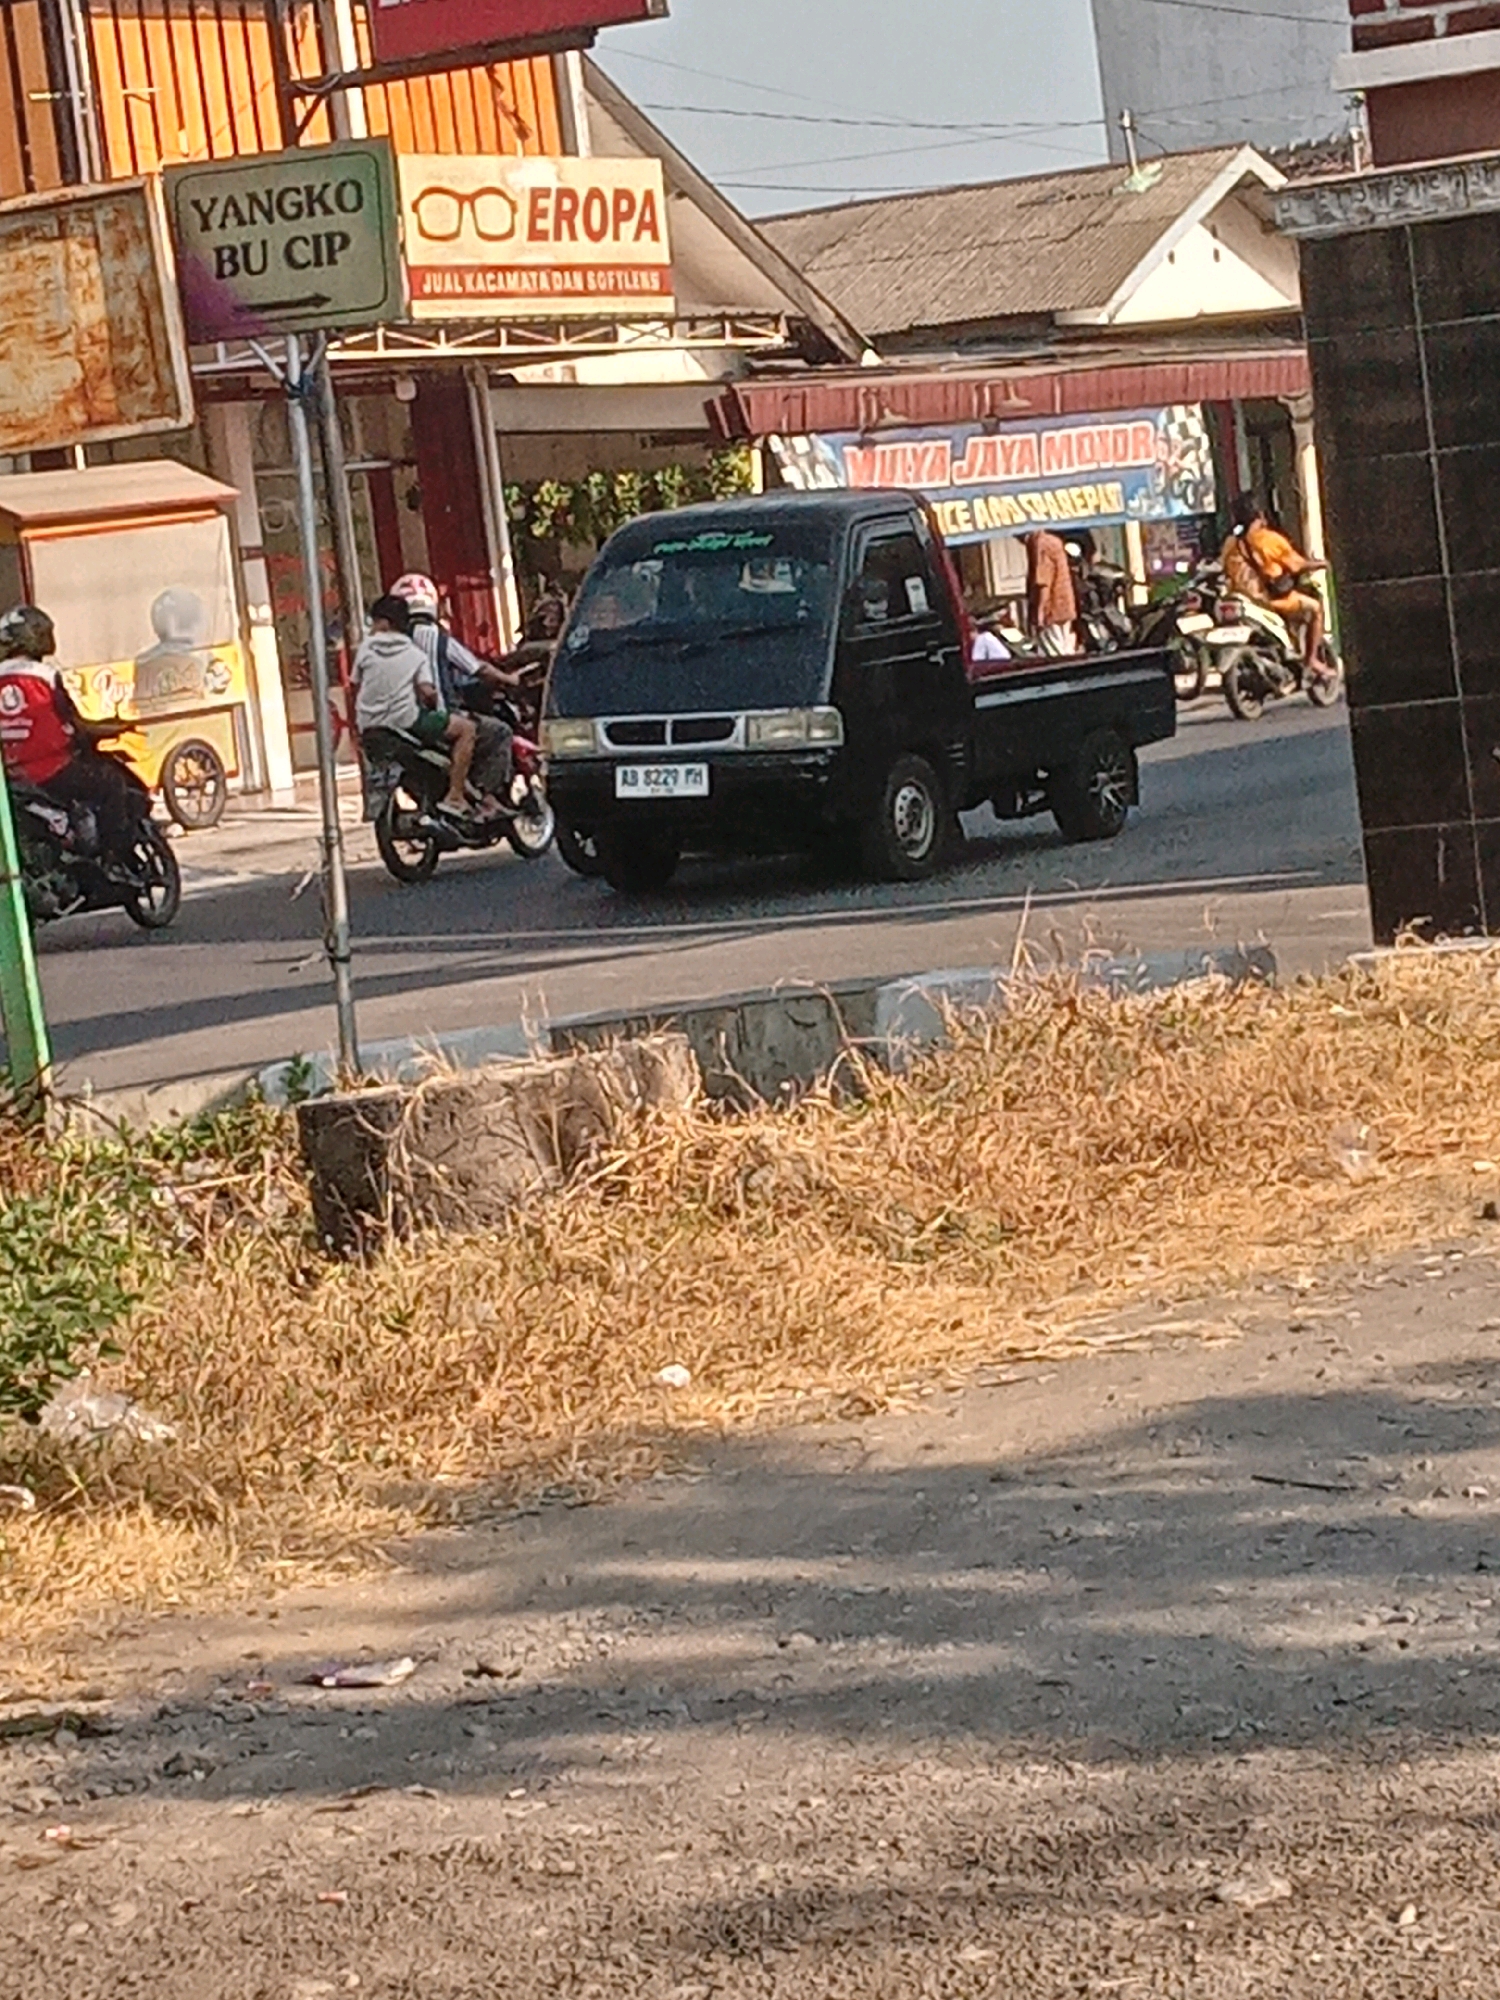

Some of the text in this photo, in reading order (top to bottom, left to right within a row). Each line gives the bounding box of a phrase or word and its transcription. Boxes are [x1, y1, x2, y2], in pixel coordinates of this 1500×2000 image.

[190, 179, 364, 233] YANGKO
[527, 187, 660, 243] EROPA
[213, 231, 351, 280] BU CIP
[423, 269, 660, 294] JUAL KACAMATA DAN SOFTLENS
[843, 421, 1156, 488] MULYA JAYA MOTOR
